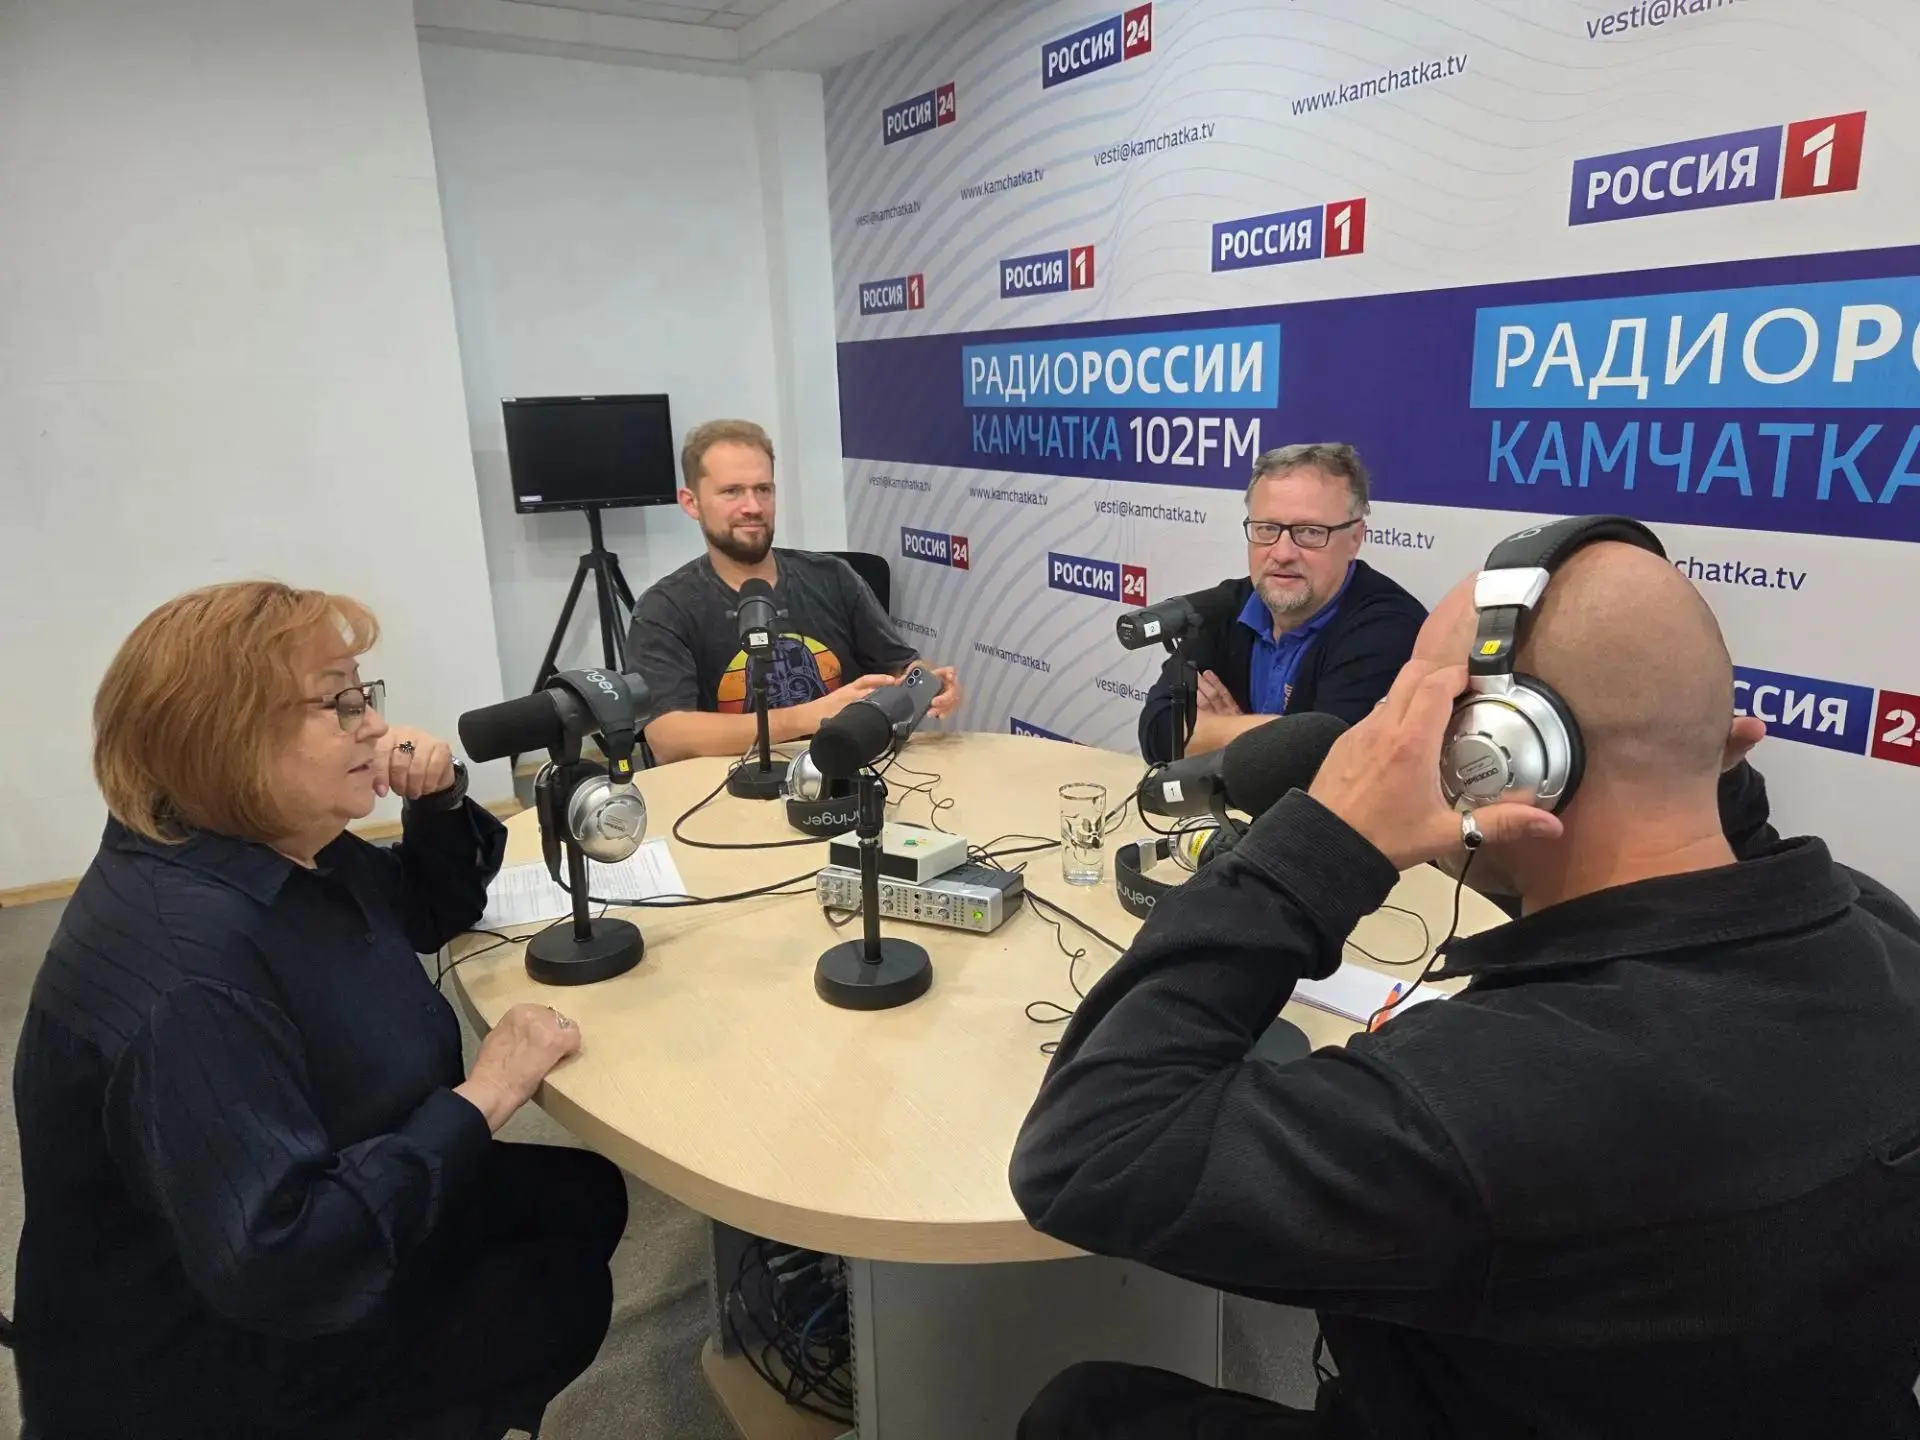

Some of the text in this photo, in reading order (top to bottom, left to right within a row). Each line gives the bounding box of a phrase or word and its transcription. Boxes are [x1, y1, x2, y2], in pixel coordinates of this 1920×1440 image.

[1586, 0, 1735, 39] vesti@ka
[1048, 14, 1149, 78] РОССИЯ 24
[1291, 53, 1468, 116] www.kamchatka.tv
[887, 91, 954, 136] РОССИЯ 24
[1093, 122, 1215, 167] vesti@kamchatka.tv
[960, 167, 1044, 200] www.kamchatka.tv
[1587, 122, 1836, 209] РОССИЯ 1
[855, 200, 921, 227] vesti@kamchatka.tv
[1219, 205, 1352, 260] РОССИЯ 1
[1005, 250, 1087, 290] РОССИЯ 1
[863, 277, 919, 309] РОССИЯ 1
[1495, 303, 1920, 400] РАДИОР
[971, 341, 1263, 403] РАДИОРОССИИ
[972, 413, 1261, 468] КАМЧАТКА 102FM
[1488, 420, 1920, 504] КАМЧАТКА
[969, 486, 1048, 506] www.kamchatka.tv
[1094, 500, 1207, 525] vesti@kamchatka.tv
[904, 533, 968, 562] РОССИЯ 24
[1054, 561, 1145, 598] РОССИЯ 24
[973, 641, 1052, 673] www.kamchatka.tv
[1881, 708, 1920, 748] 2
